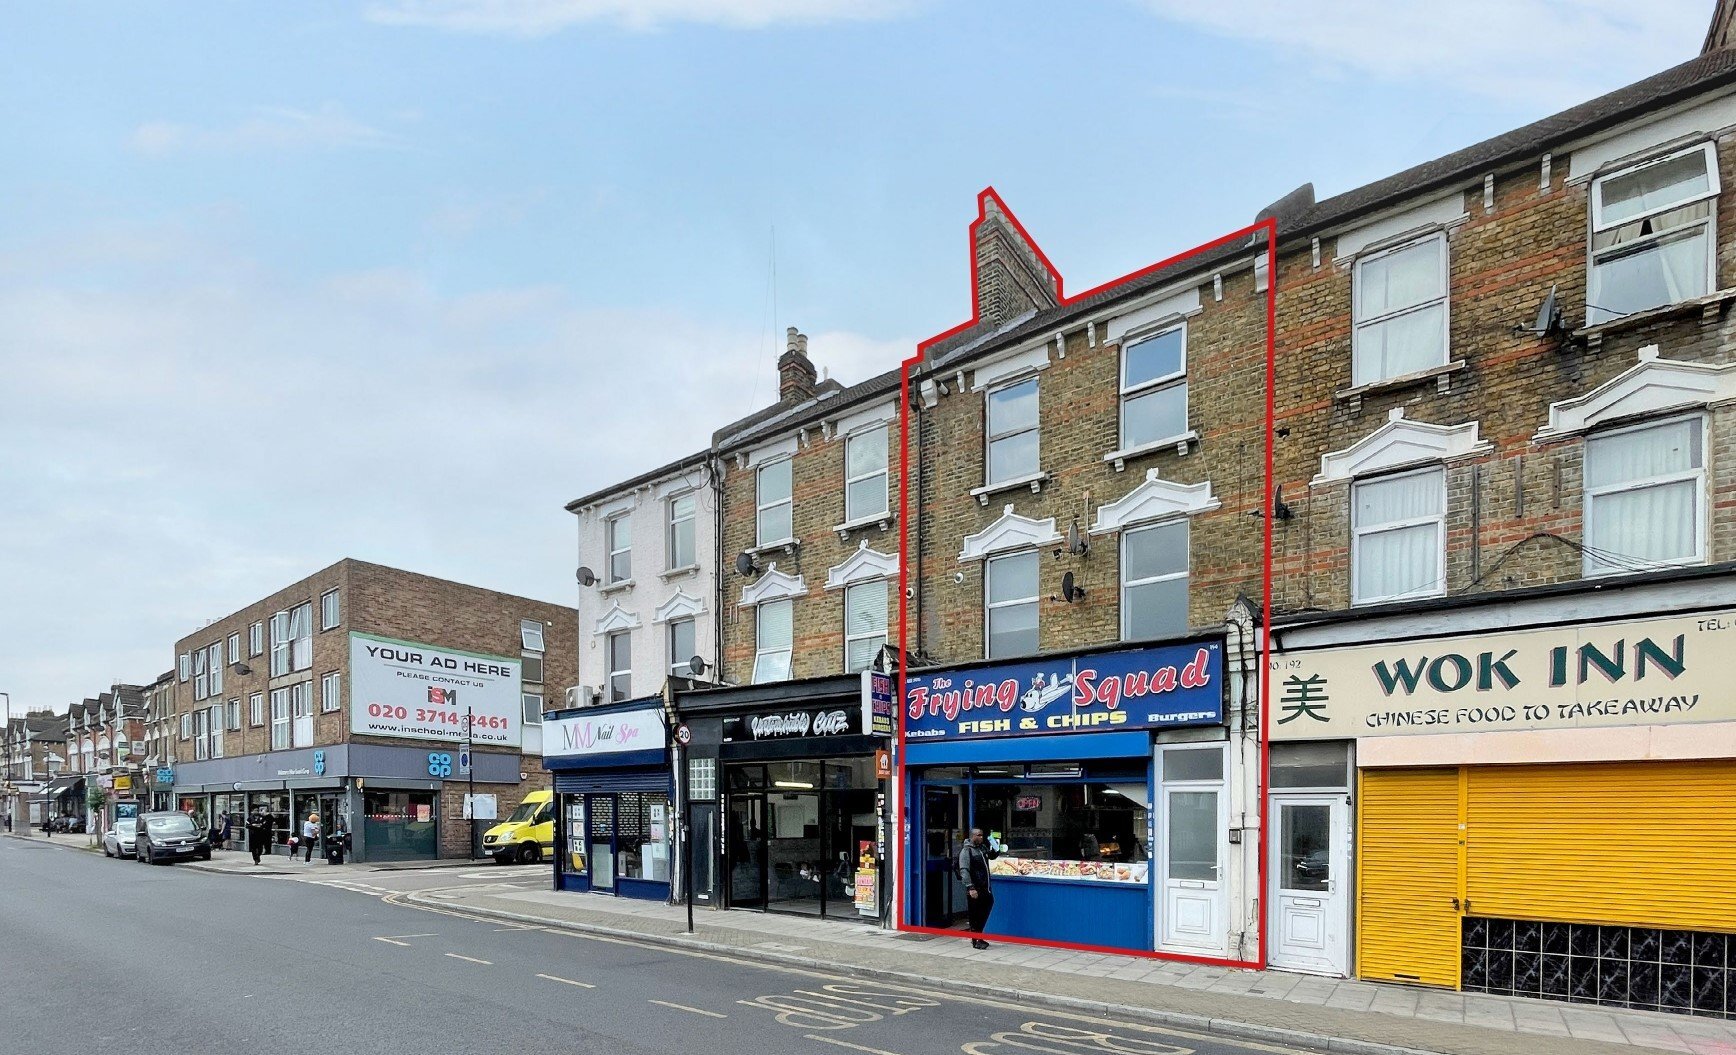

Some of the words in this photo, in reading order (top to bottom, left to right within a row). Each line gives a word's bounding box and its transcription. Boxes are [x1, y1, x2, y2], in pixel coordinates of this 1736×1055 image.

[365, 645, 423, 664] YOUR
[430, 656, 458, 670] AD
[464, 661, 511, 678] HERE
[1285, 659, 1302, 670] 192
[1371, 649, 1522, 697] WOK
[1548, 633, 1687, 689] INN
[396, 671, 430, 681] PLEASE
[432, 676, 471, 687] CONTACT
[872, 676, 890, 696] FISH
[908, 678, 1019, 721] Frying
[1074, 648, 1210, 710] Squad
[932, 677, 952, 689] The
[872, 699, 891, 715] CHIPS
[1277, 673, 1331, 725] 美
[368, 703, 408, 720] 020
[415, 708, 459, 725] 3714
[1147, 710, 1216, 722] Burgers
[1366, 708, 1450, 728] CHINESE
[1456, 705, 1516, 724] FOOD
[1523, 704, 1550, 720] TO
[1557, 694, 1699, 719] TAKEAWAY
[958, 718, 1011, 734] FISH
[1019, 717, 1039, 730] &
[1046, 710, 1127, 728] CHIPS
[596, 723, 614, 740] Nail
[616, 723, 640, 744] Spa
[680, 730, 689, 740] 20
